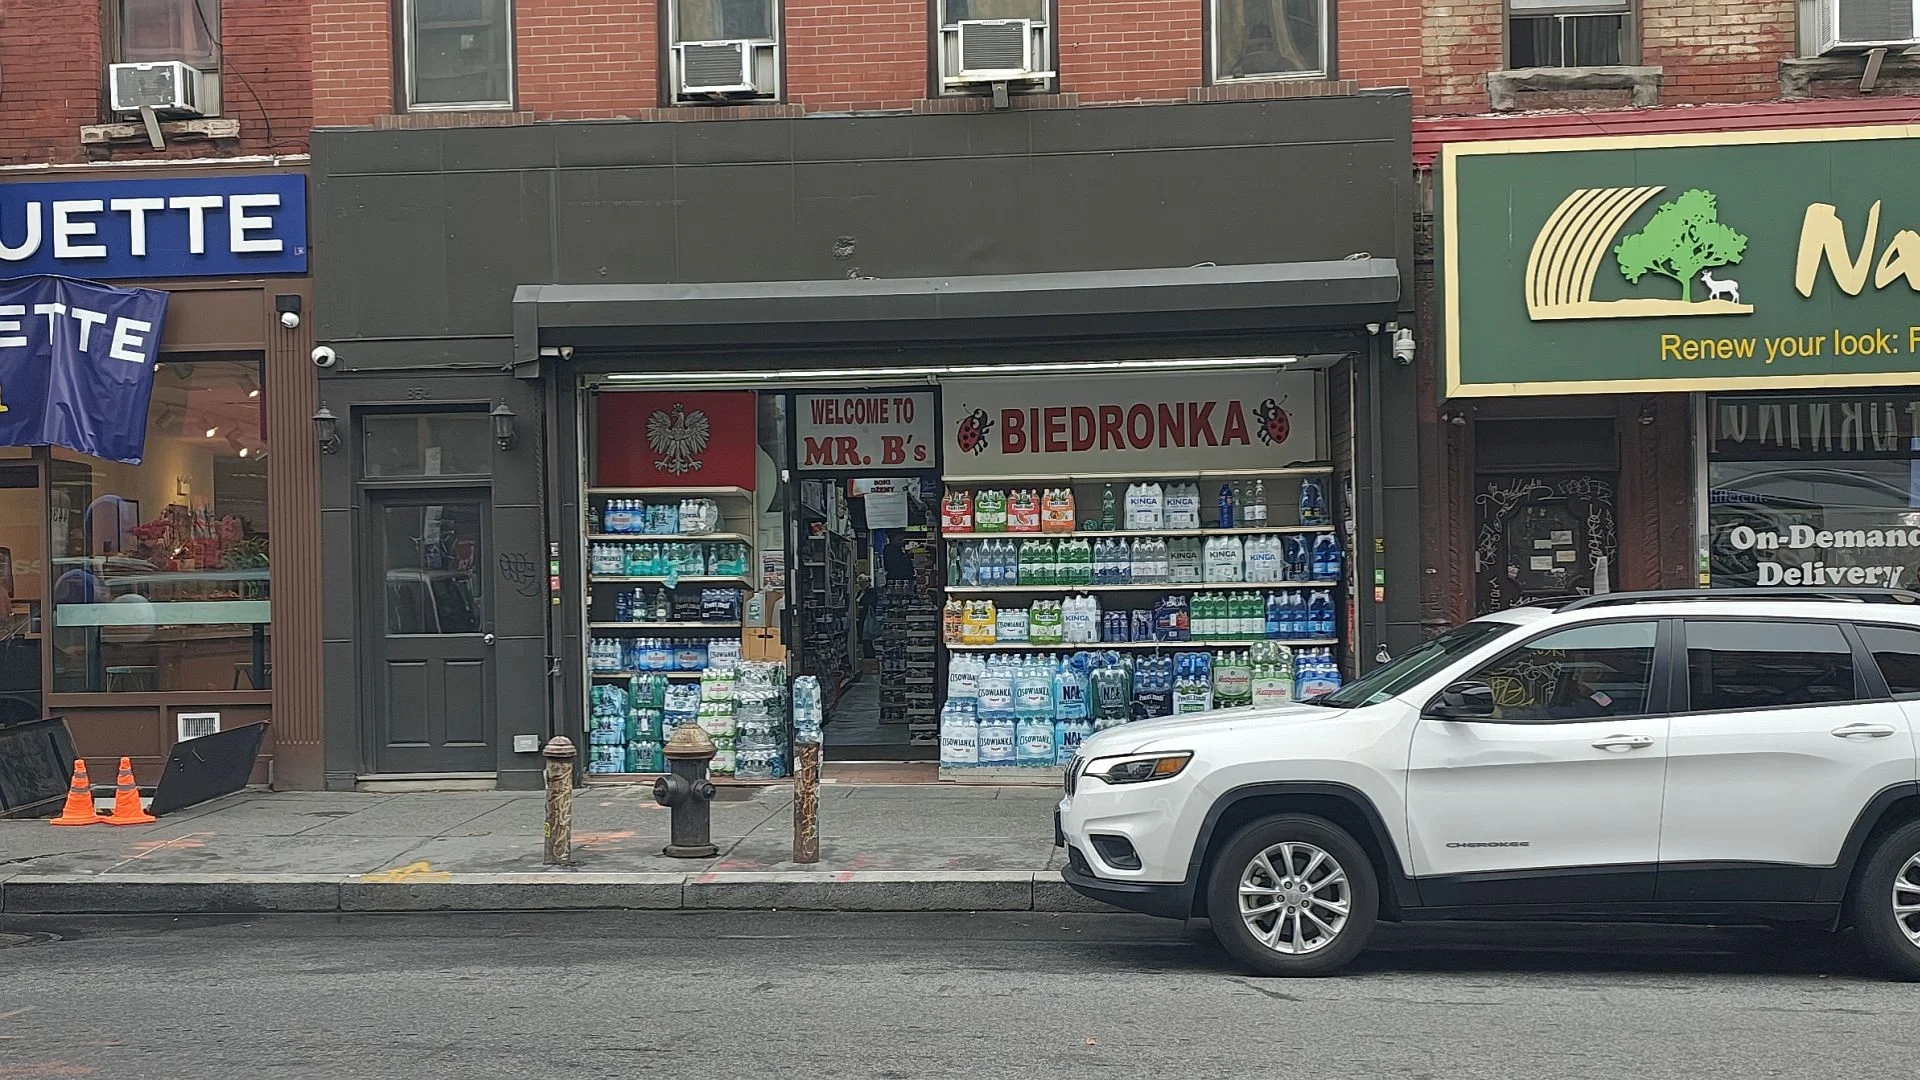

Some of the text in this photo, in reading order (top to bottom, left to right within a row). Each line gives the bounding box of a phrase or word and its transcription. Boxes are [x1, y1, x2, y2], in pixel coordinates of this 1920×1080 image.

[0, 194, 283, 261] UETTE
[0, 303, 151, 363] ETTE
[1661, 334, 1756, 361] Renew
[1764, 335, 1826, 364] your
[1834, 328, 1899, 356] look:
[810, 397, 914, 425] WELCOME TO
[1001, 400, 1251, 454] BIEDRONKA
[803, 434, 927, 466] MR. B's
[1130, 497, 1158, 505] KINGA
[1167, 497, 1194, 505] KINGA
[1170, 551, 1198, 560] KINGA
[1209, 550, 1237, 559] KINGA
[1250, 553, 1276, 561] KINGA
[1756, 561, 1905, 589] Delivery
[1065, 614, 1090, 622] KINGA
[978, 688, 1012, 698] CISOWIANKA
[1017, 687, 1049, 698] CISOWIANKA
[942, 737, 976, 748] CISOWIANKA
[979, 736, 1013, 747] CISOWIANKA
